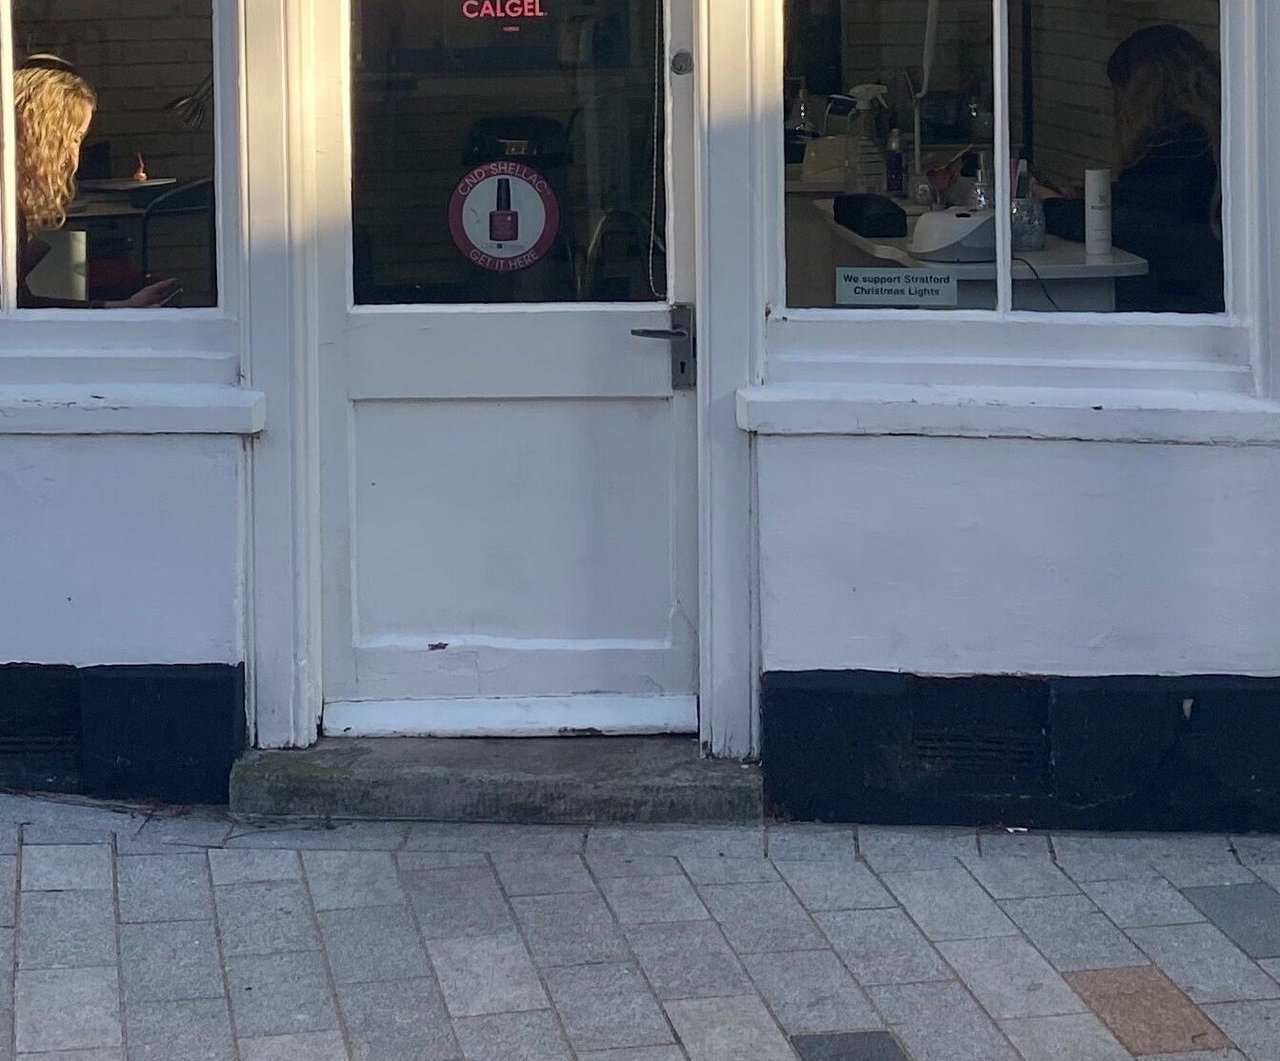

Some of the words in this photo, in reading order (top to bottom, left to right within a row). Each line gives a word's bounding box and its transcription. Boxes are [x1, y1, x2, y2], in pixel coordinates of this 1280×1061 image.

[458, 168, 486, 196] CND
[489, 162, 548, 193] SHELLAC
[469, 249, 493, 268] GET
[495, 258, 506, 270] IT
[508, 250, 540, 270] HERE
[843, 273, 859, 284] We
[862, 274, 901, 285] support
[904, 274, 951, 285] Stratford
[853, 285, 905, 296] Christmas
[908, 286, 940, 298] Lights
